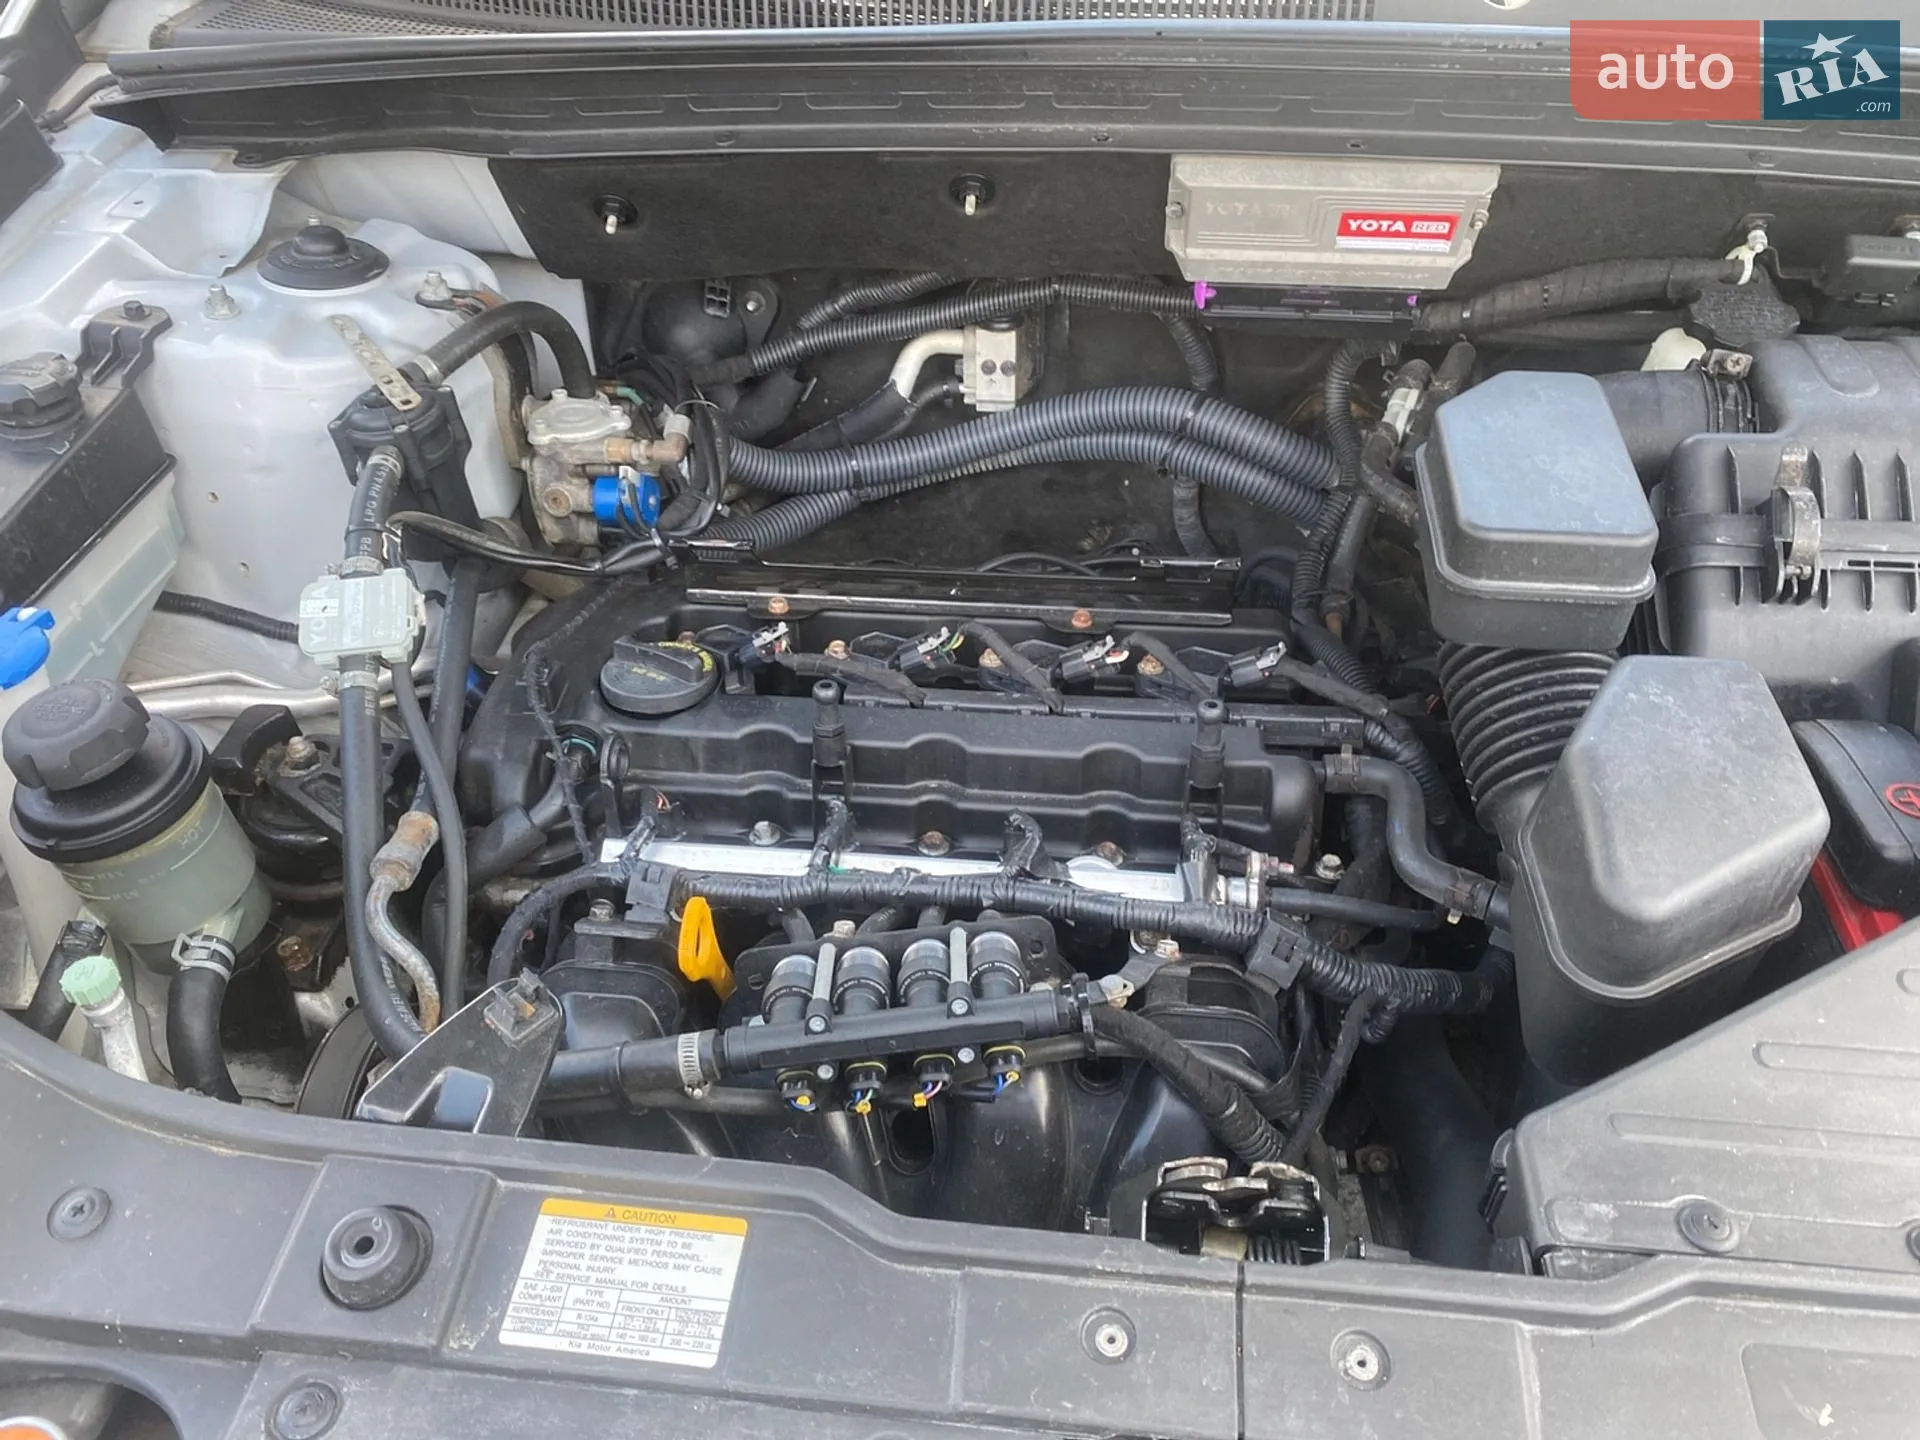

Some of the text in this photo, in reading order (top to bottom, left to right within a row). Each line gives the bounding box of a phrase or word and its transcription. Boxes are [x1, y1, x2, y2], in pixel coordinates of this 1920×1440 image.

[1347, 218, 1448, 233] YOTA RED
[309, 585, 329, 648] YOA
[622, 1209, 677, 1225] CAUTION
[552, 1219, 608, 1230] REFRIGERANT
[613, 1224, 641, 1233] UNDER
[644, 1227, 666, 1236] HIGH
[545, 1238, 587, 1250] SERVICED
[590, 1242, 602, 1250] BY
[605, 1244, 648, 1256] QUALIFIED
[548, 1228, 693, 1250] AIR CONDITIONING SYSTEM TO BE
[538, 1259, 582, 1271] PERSONAL
[541, 1249, 723, 1276] IMPROPER SERVICE METHODS MAY CAUSE
[555, 1272, 591, 1283] SERVICE
[595, 1276, 628, 1287] MANUAL
[630, 1280, 648, 1289] FOR
[518, 1291, 562, 1303] COMPLIANT
[586, 1288, 605, 1298] TYPE
[659, 1296, 692, 1306] AMOUNT
[621, 1305, 646, 1314] FRONT
[646, 1307, 667, 1317] ONLY
[568, 1340, 650, 1356] Kia Motor America
